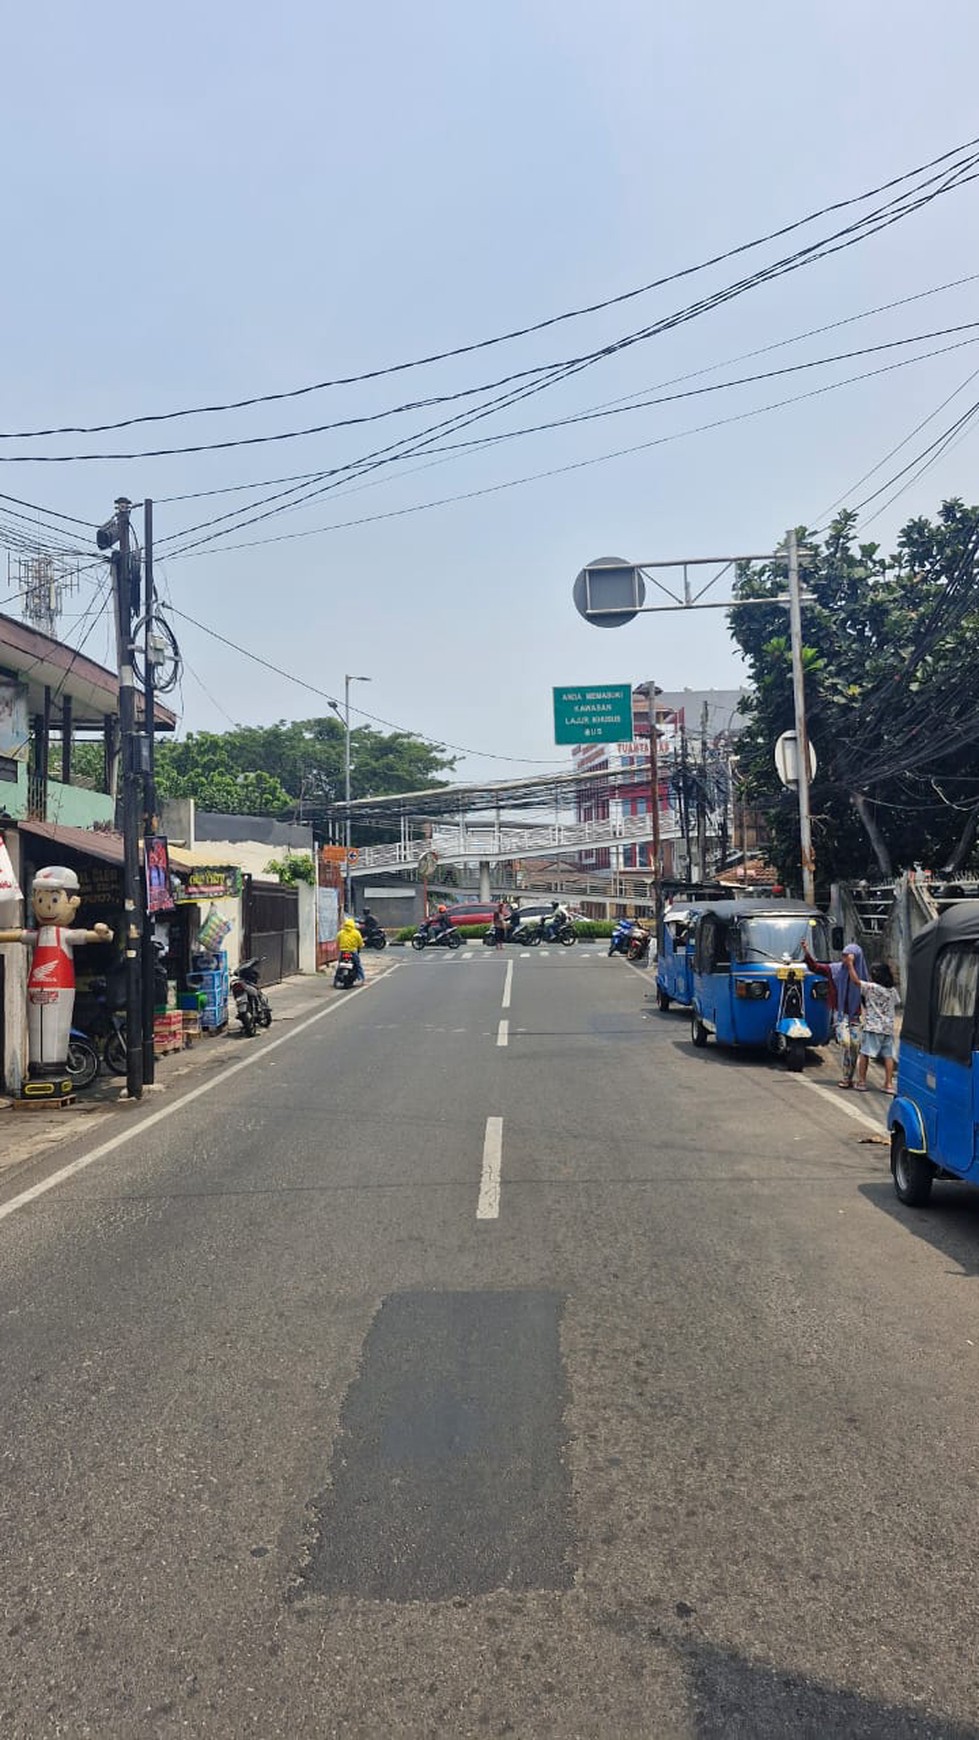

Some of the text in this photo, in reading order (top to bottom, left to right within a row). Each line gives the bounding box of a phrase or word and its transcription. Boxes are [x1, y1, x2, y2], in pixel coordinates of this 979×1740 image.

[562, 692, 624, 701] ANDA MEMASUKI
[574, 704, 612, 712] KAWASAN
[565, 715, 621, 725] LAJUR KHUSUS
[584, 728, 603, 736] BUS
